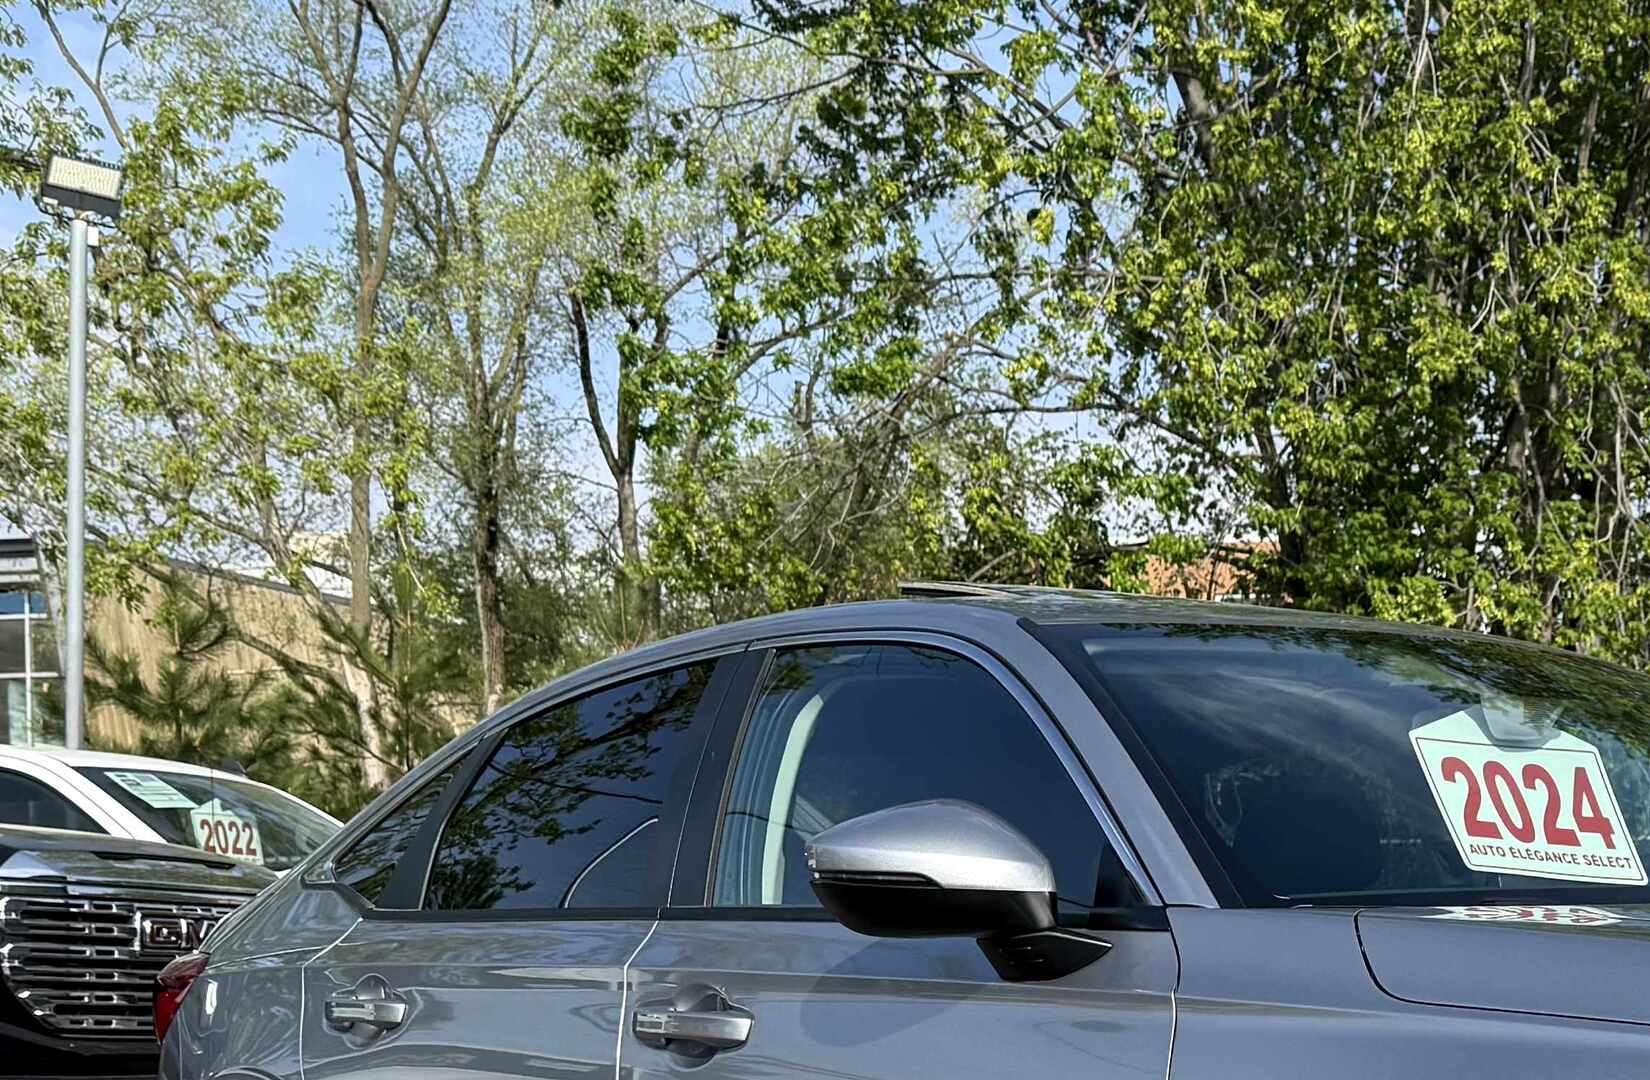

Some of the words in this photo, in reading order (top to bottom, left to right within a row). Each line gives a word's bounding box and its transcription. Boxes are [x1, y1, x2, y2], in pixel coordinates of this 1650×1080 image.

[1440, 756, 1617, 850] 2024
[201, 818, 257, 857] 2022
[1469, 843, 1506, 857] AUTO
